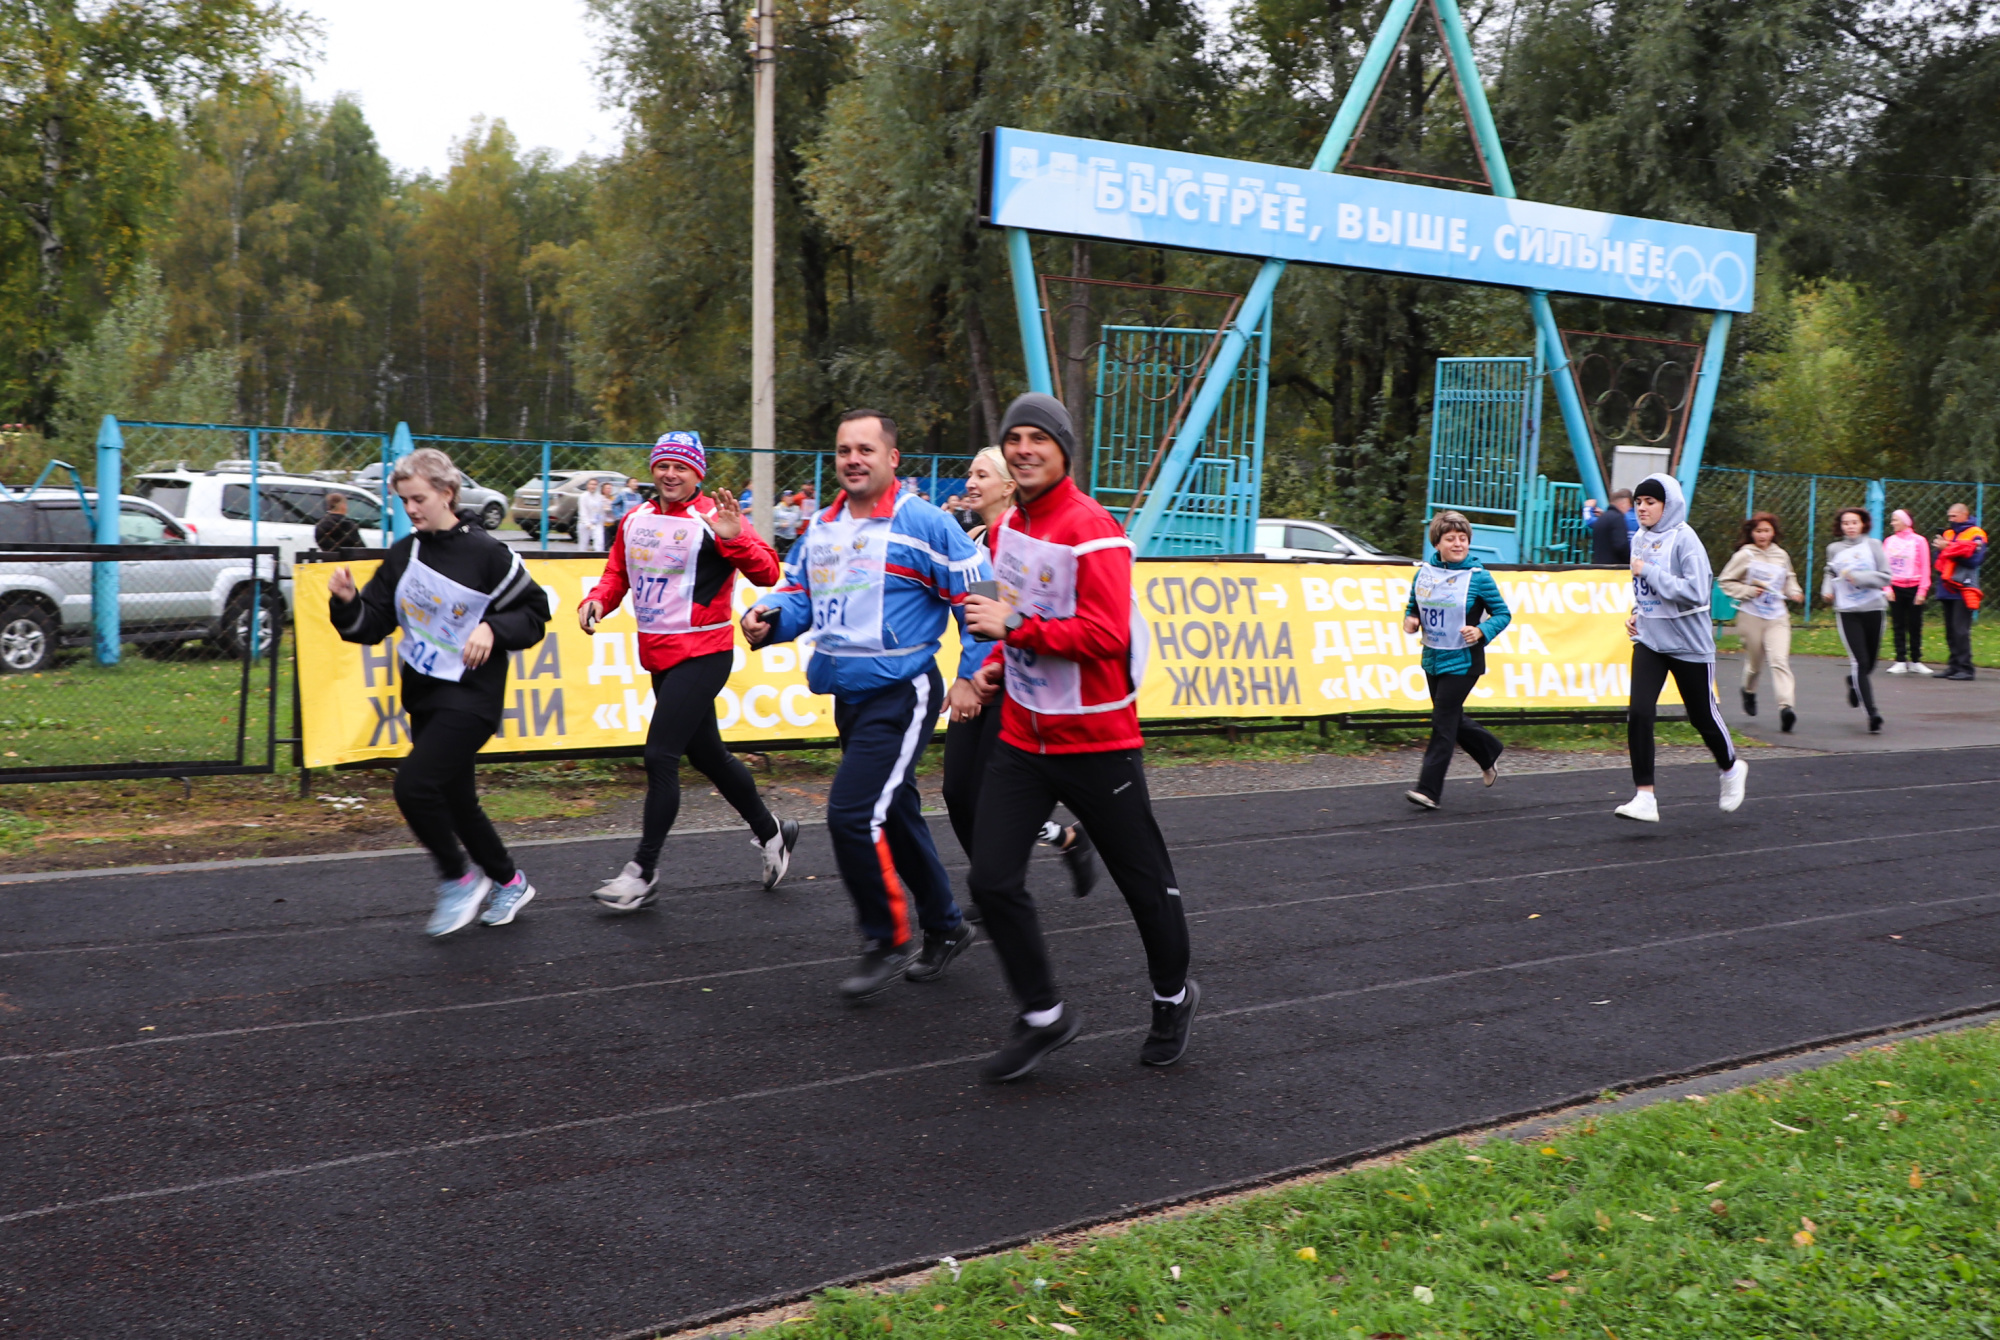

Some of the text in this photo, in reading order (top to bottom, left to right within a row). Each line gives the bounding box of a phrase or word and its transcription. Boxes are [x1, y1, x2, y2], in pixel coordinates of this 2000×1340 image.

[1095, 169, 1678, 281] БЫСТРЕЕ, ВЫШЕ, СИЛЬНЕЕ.
[636, 575, 668, 604] 977
[1146, 576, 1259, 614] СПОРТ
[1422, 607, 1445, 628] 781
[1153, 620, 1295, 660] НОРМА
[1164, 666, 1302, 706] ЖИЗНИ
